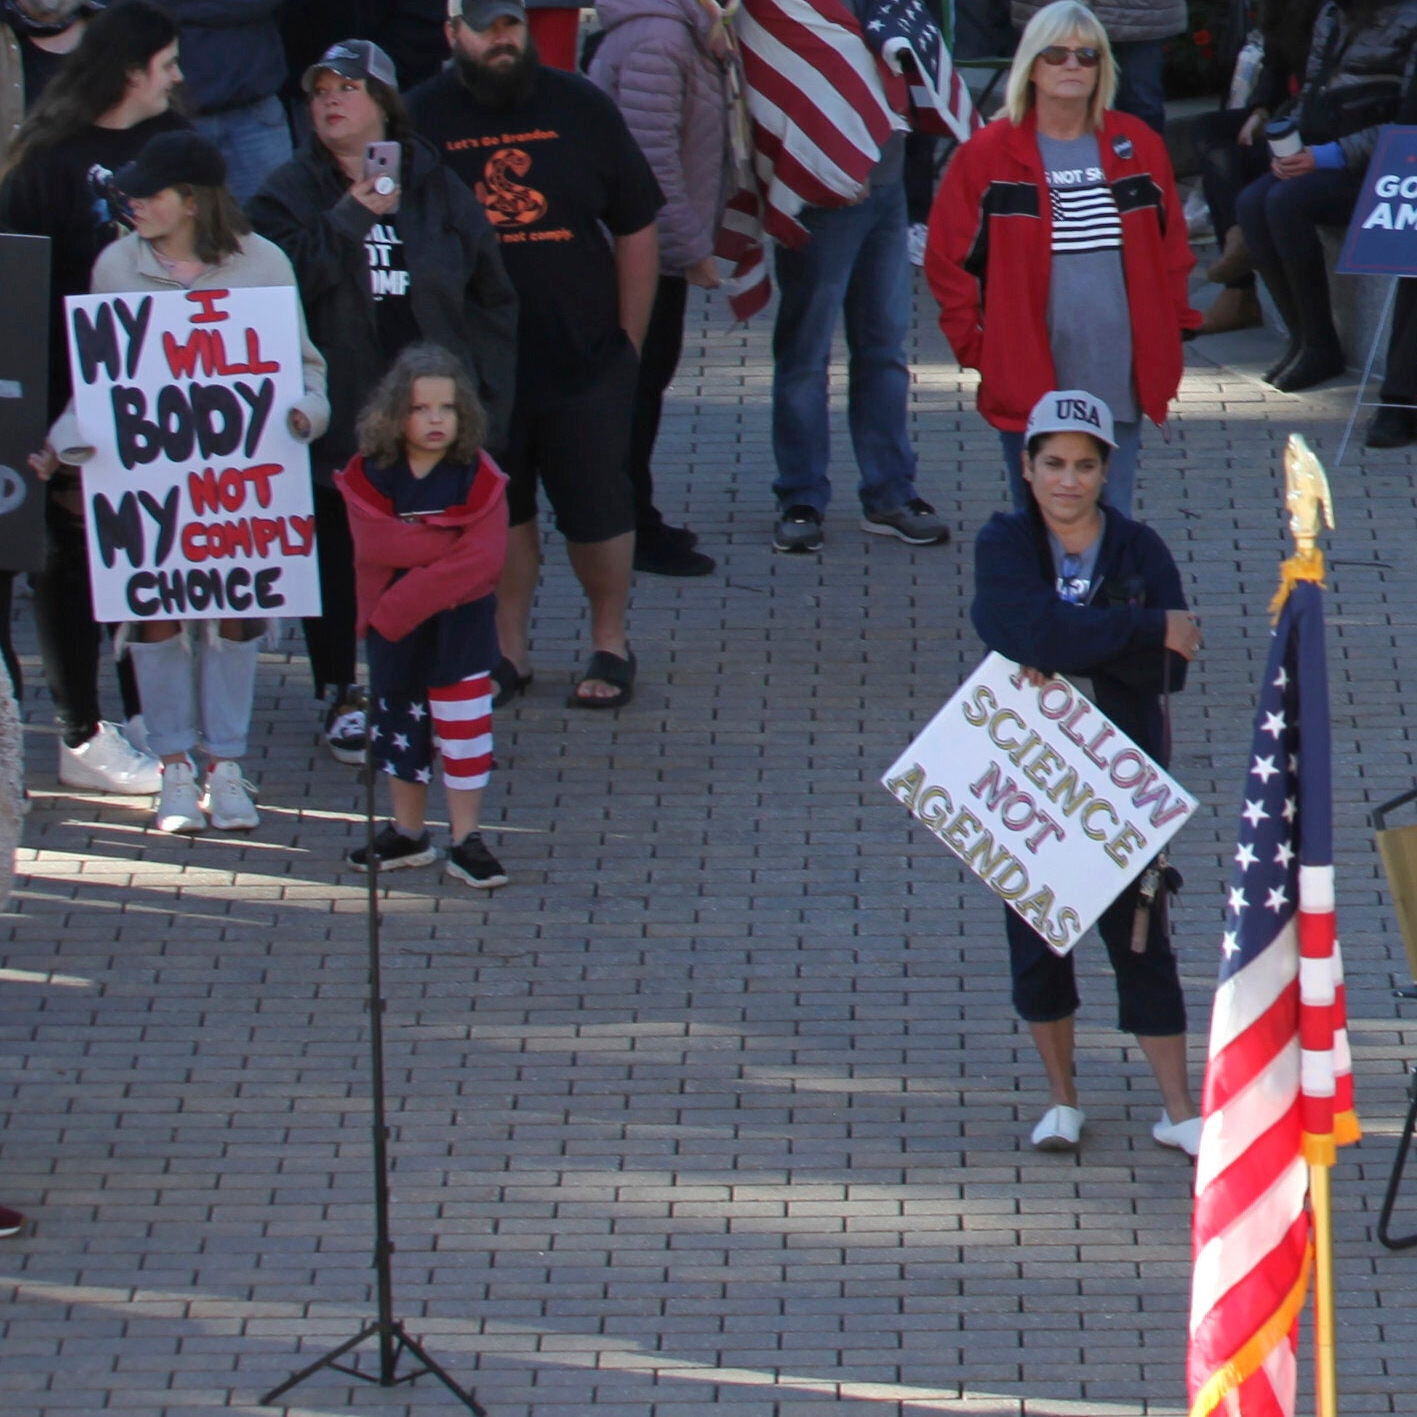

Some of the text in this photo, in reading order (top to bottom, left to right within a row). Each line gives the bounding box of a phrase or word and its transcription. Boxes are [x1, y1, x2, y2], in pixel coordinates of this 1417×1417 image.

[1051, 169, 1083, 184] NOT
[185, 289, 230, 323] I
[73, 295, 154, 385] MY
[162, 327, 280, 380] WILL
[111, 377, 275, 470] BODY
[1056, 398, 1102, 430] USA
[187, 463, 284, 517] NOT
[93, 485, 180, 569] MY
[181, 514, 316, 563] COMPLY
[126, 566, 286, 617] CHOICE
[962, 685, 1148, 869] SCIENCE
[969, 760, 1067, 855] NOT
[886, 761, 1082, 947] AGENDAS
